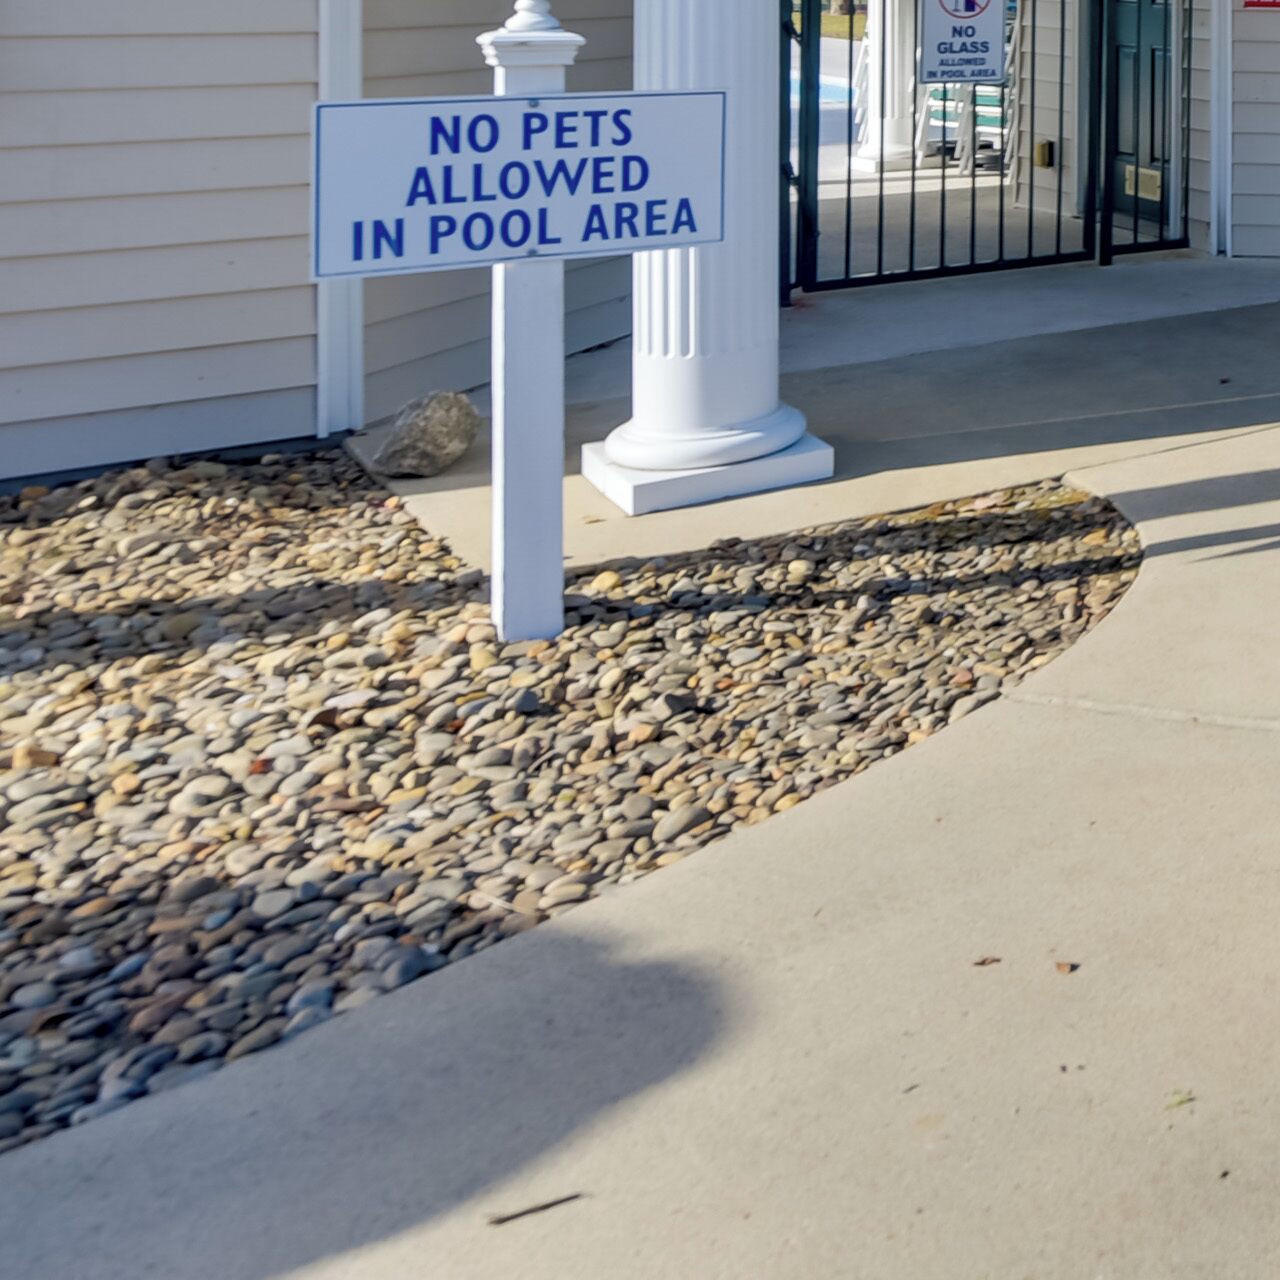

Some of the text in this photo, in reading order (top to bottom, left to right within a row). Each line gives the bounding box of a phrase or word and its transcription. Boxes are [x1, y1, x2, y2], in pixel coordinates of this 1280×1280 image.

[952, 26, 976, 38] NO
[937, 41, 990, 54] GLASS
[938, 58, 986, 66] ALLOWED
[927, 69, 996, 78] IN POOL AREA
[430, 109, 632, 155] NO PETS
[405, 155, 650, 207] ALLOWED
[352, 198, 697, 261] IN POOL AREA
